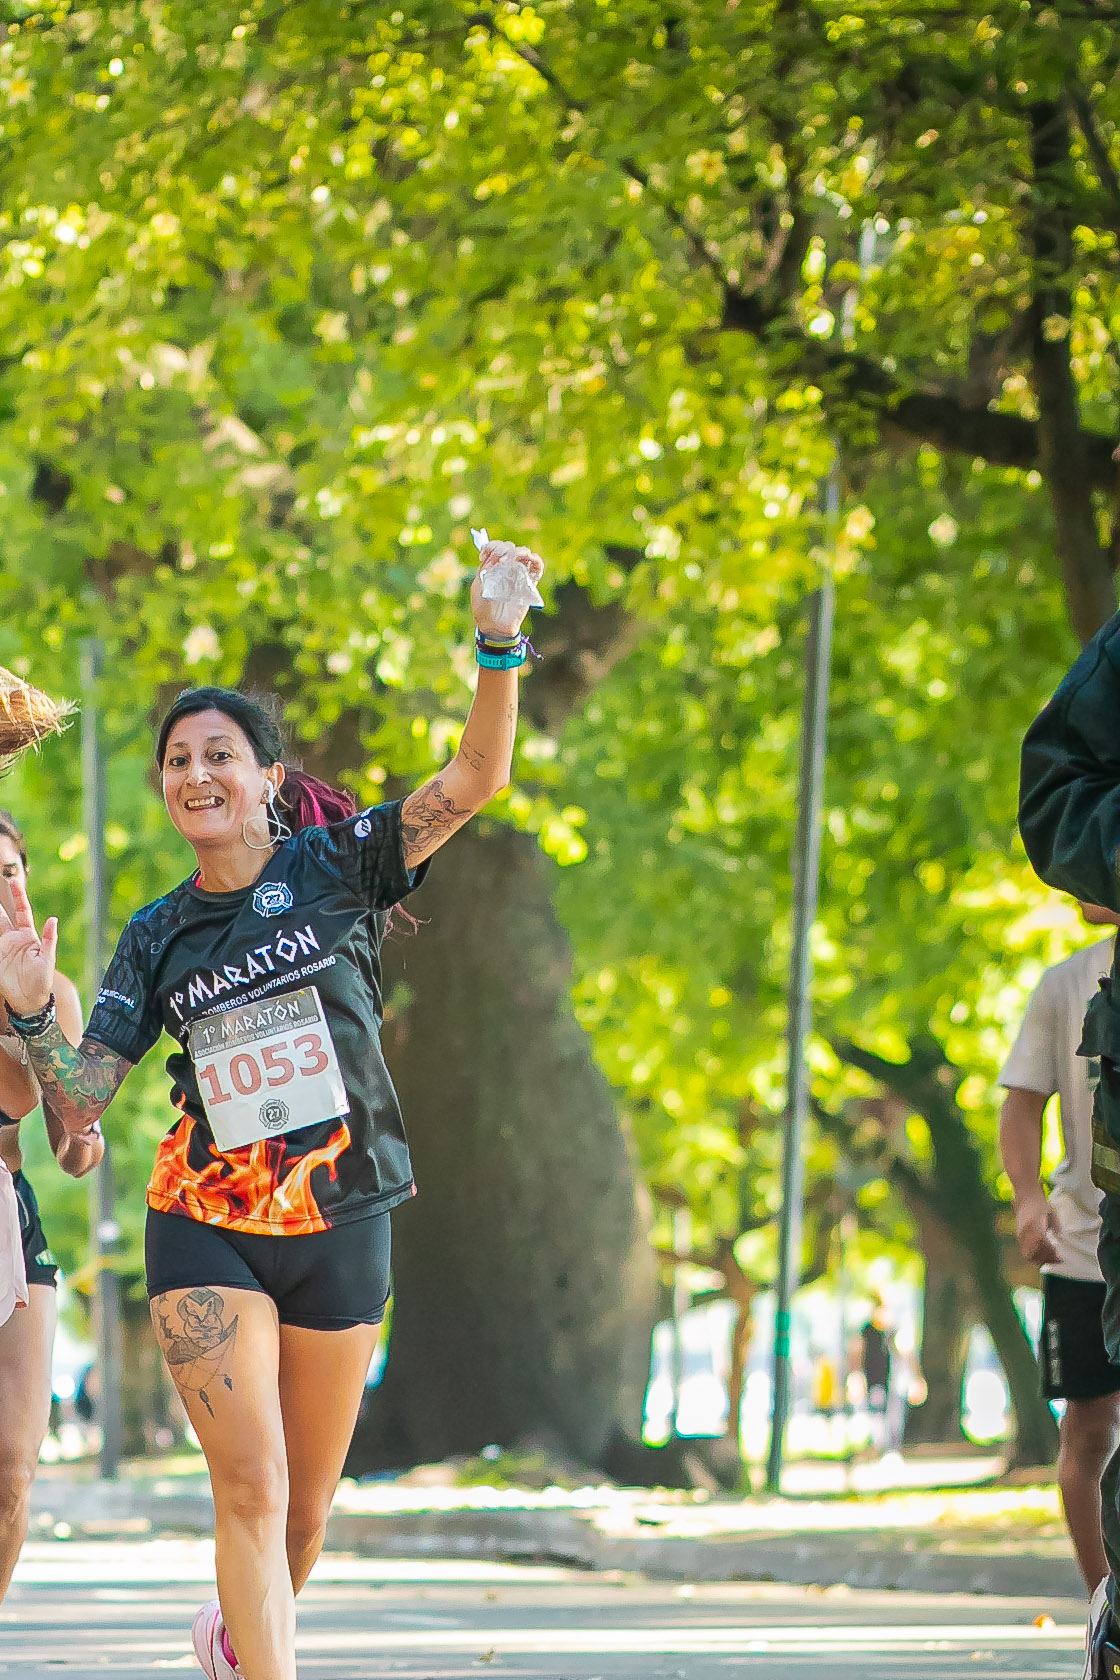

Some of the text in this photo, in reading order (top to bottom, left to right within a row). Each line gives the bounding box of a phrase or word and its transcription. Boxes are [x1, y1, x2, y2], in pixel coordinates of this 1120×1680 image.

[188, 924, 320, 1008] MARATÓN
[248, 969, 301, 1001] VOLUNTARIOS
[301, 955, 337, 976] ROSARIO
[221, 1000, 301, 1038] MARATÓN
[199, 1033, 329, 1106] 1053
